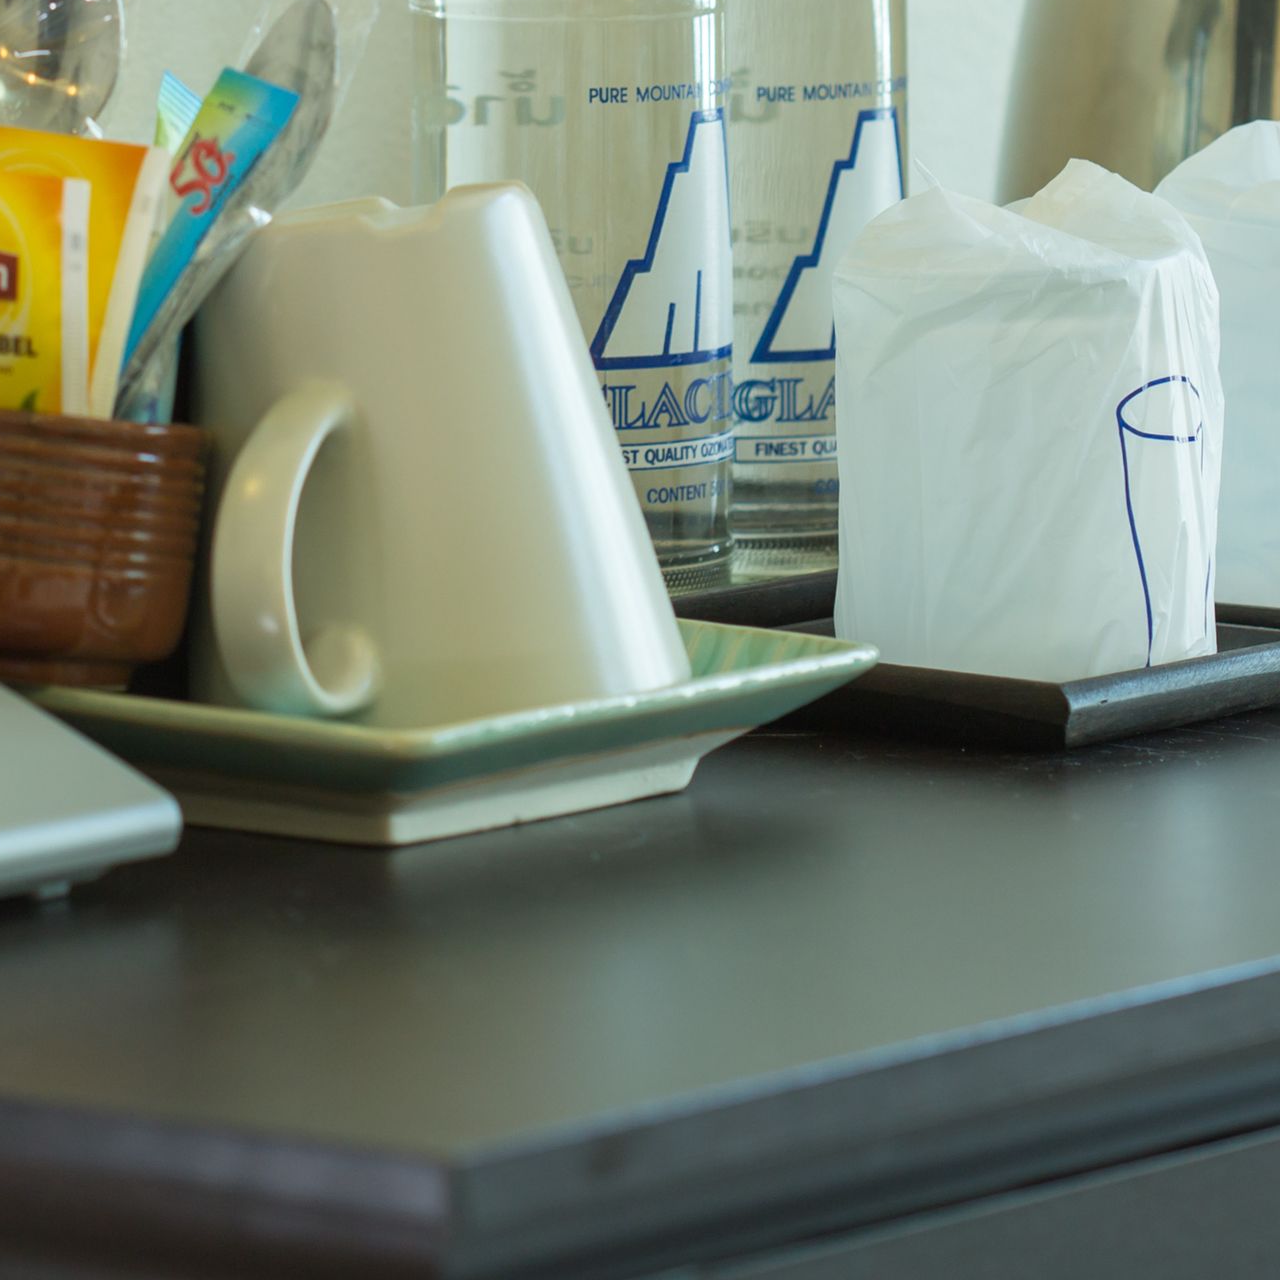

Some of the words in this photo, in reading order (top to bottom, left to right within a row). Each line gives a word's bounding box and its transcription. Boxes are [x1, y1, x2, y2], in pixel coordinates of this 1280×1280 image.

[588, 86, 628, 104] PURE
[756, 85, 796, 103] PURE
[644, 445, 698, 465] QUALITY
[755, 441, 808, 457] FINEST
[646, 482, 707, 504] CONTENT
